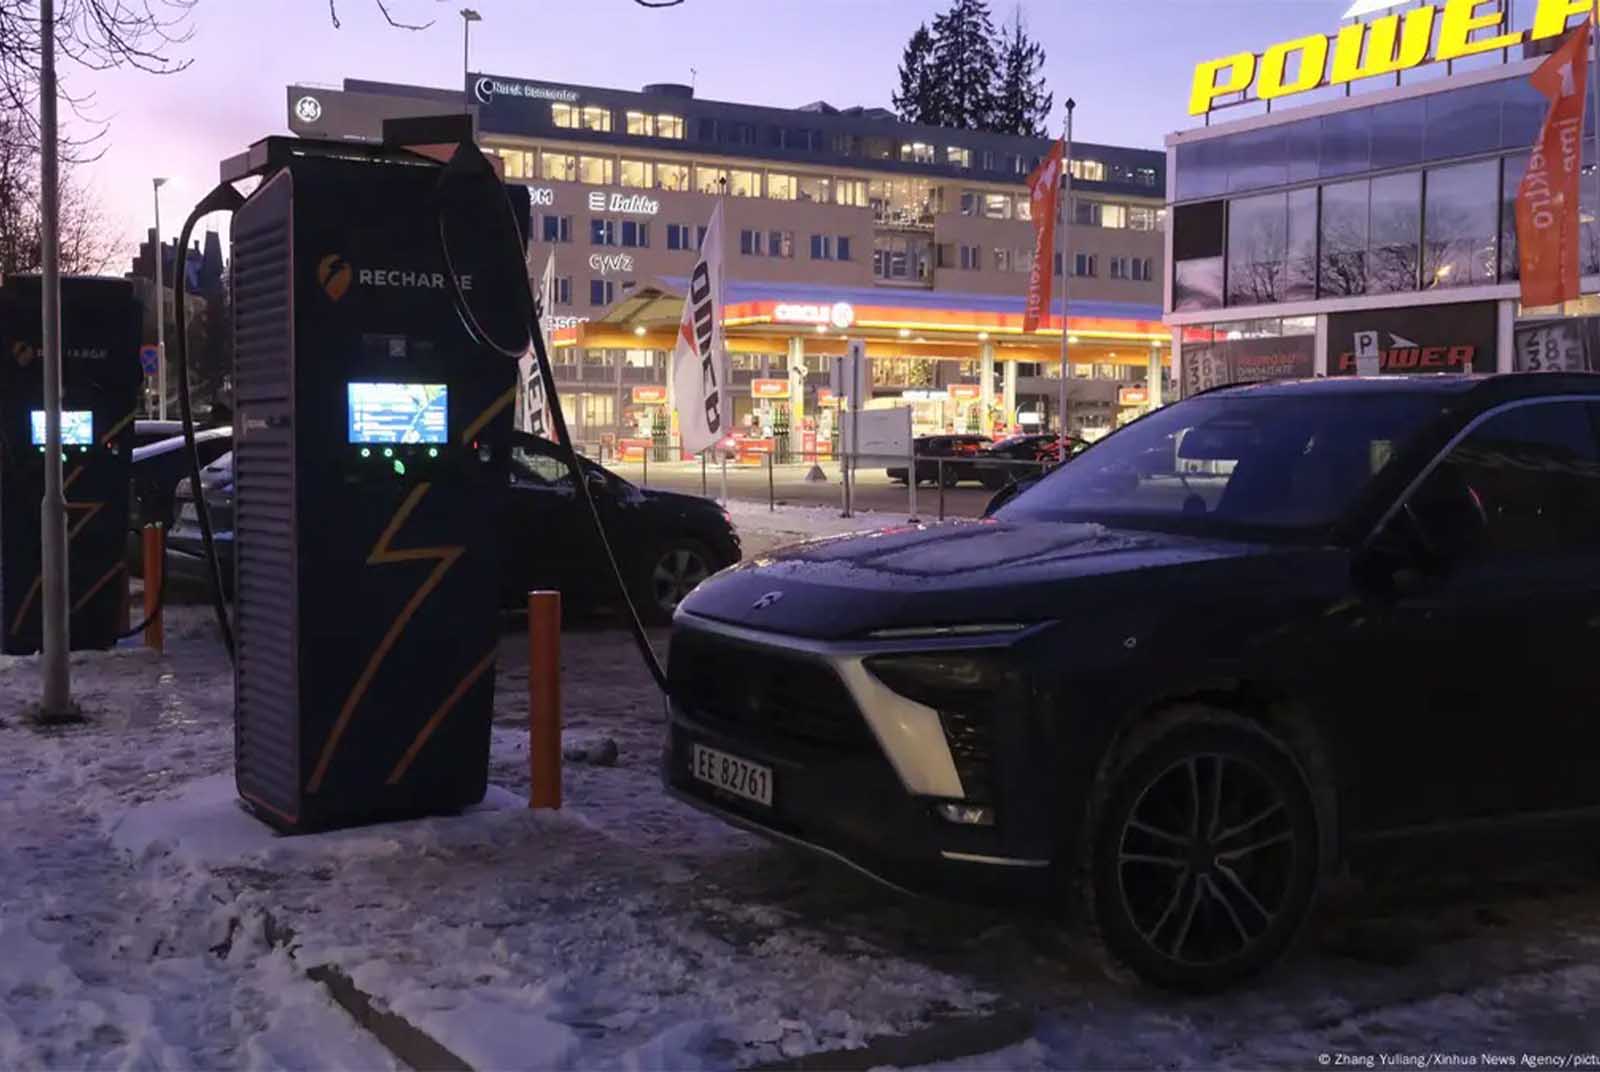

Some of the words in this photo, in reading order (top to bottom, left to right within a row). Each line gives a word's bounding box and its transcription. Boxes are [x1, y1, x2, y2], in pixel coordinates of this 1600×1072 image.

[609, 193, 659, 215] Bakke
[359, 269, 473, 290] RECHARE
[1339, 345, 1477, 370] PWER
[699, 749, 716, 781] EE
[721, 756, 767, 800] 82761
